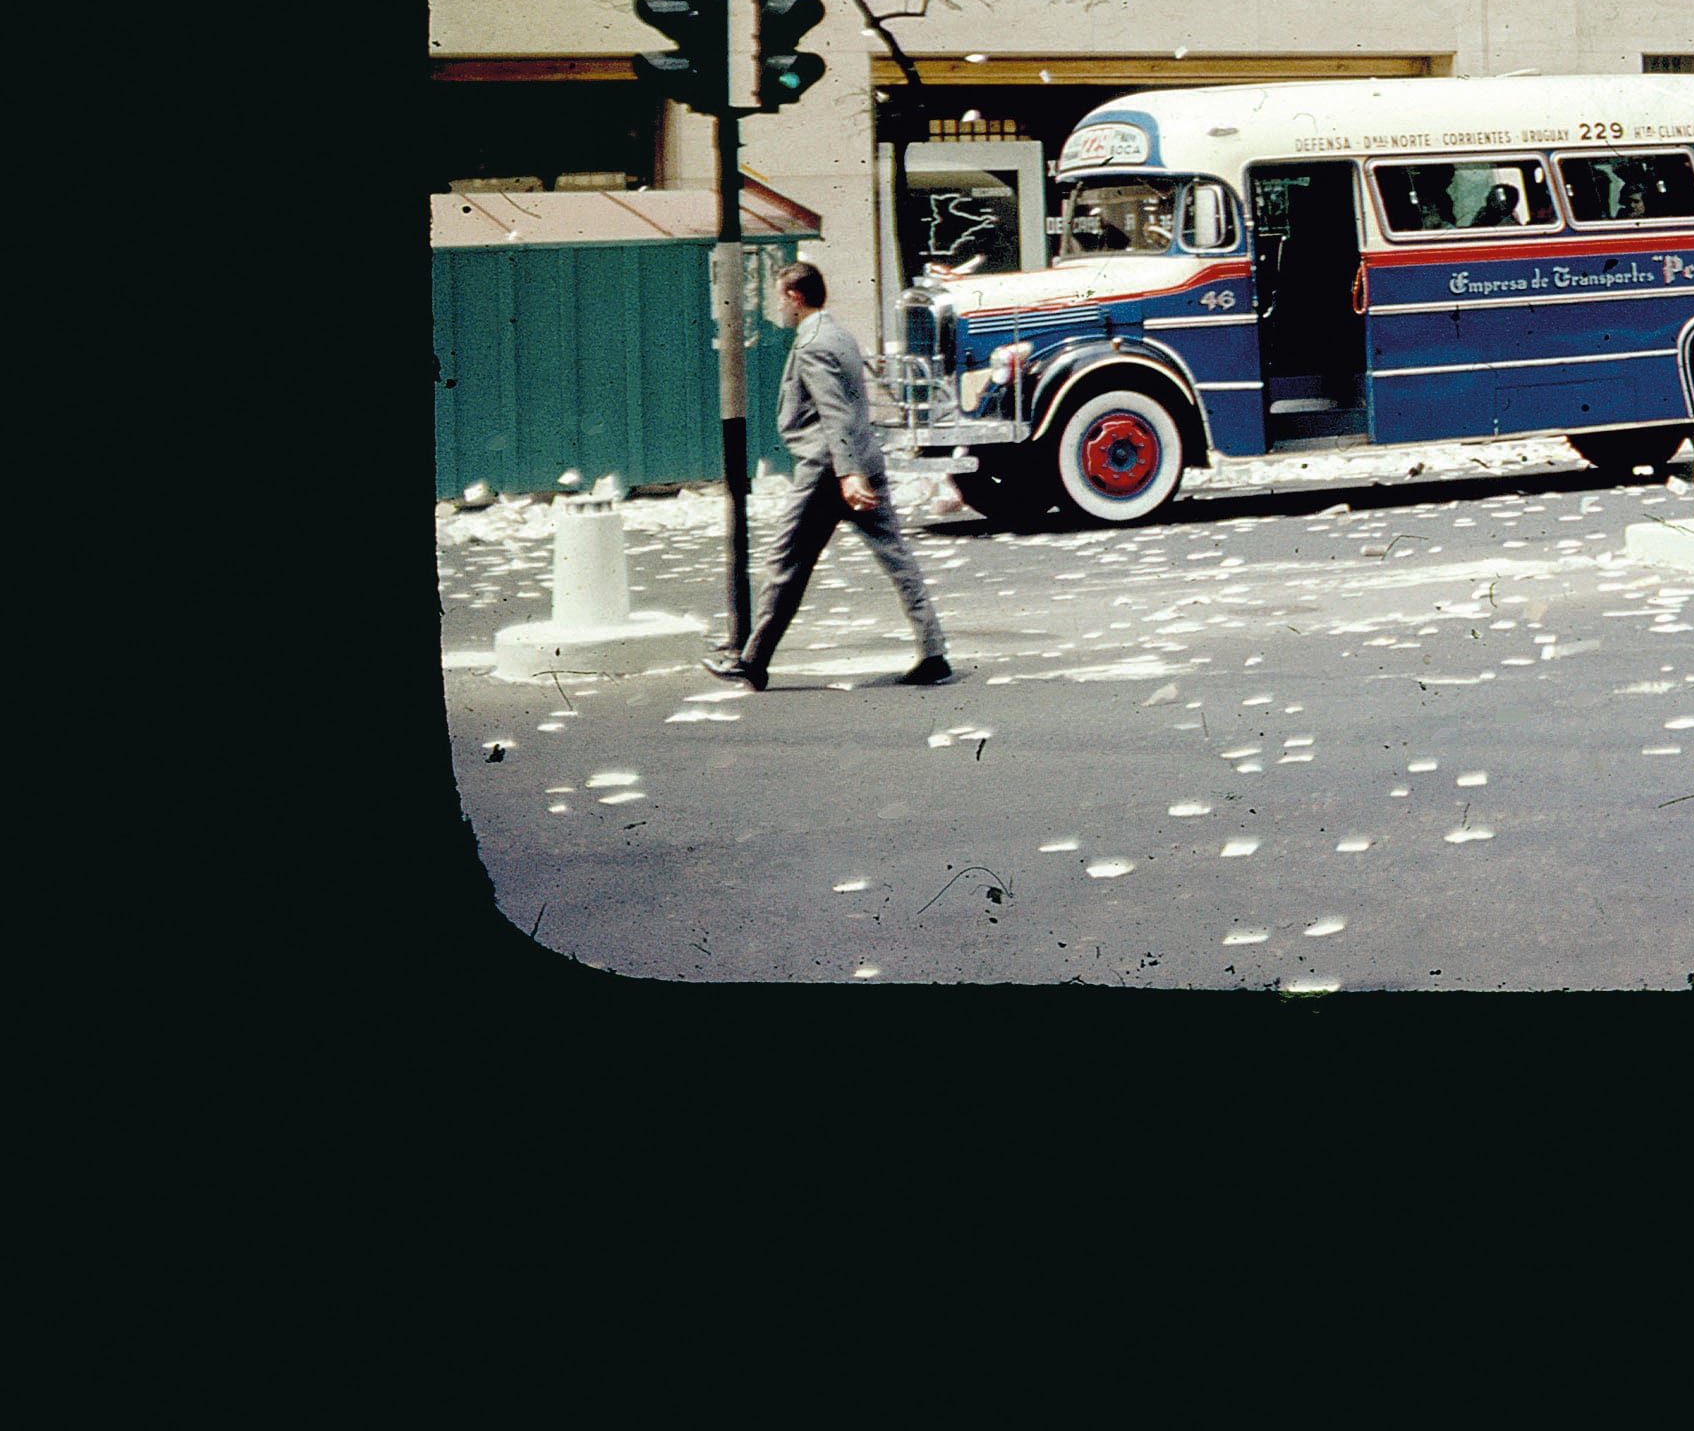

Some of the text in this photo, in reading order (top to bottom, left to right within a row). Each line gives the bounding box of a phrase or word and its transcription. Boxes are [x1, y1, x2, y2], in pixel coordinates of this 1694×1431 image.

[1295, 137, 1352, 152] DEFENSA
[1391, 134, 1431, 148] NORTE
[1442, 131, 1512, 146] CORRIENTES
[1521, 129, 1569, 143] URUGUAY
[1578, 122, 1625, 141] 229
[1449, 271, 1528, 295] Empresa
[1531, 268, 1549, 289] de
[1553, 262, 1655, 288] Transportes
[1200, 290, 1236, 311] 46
